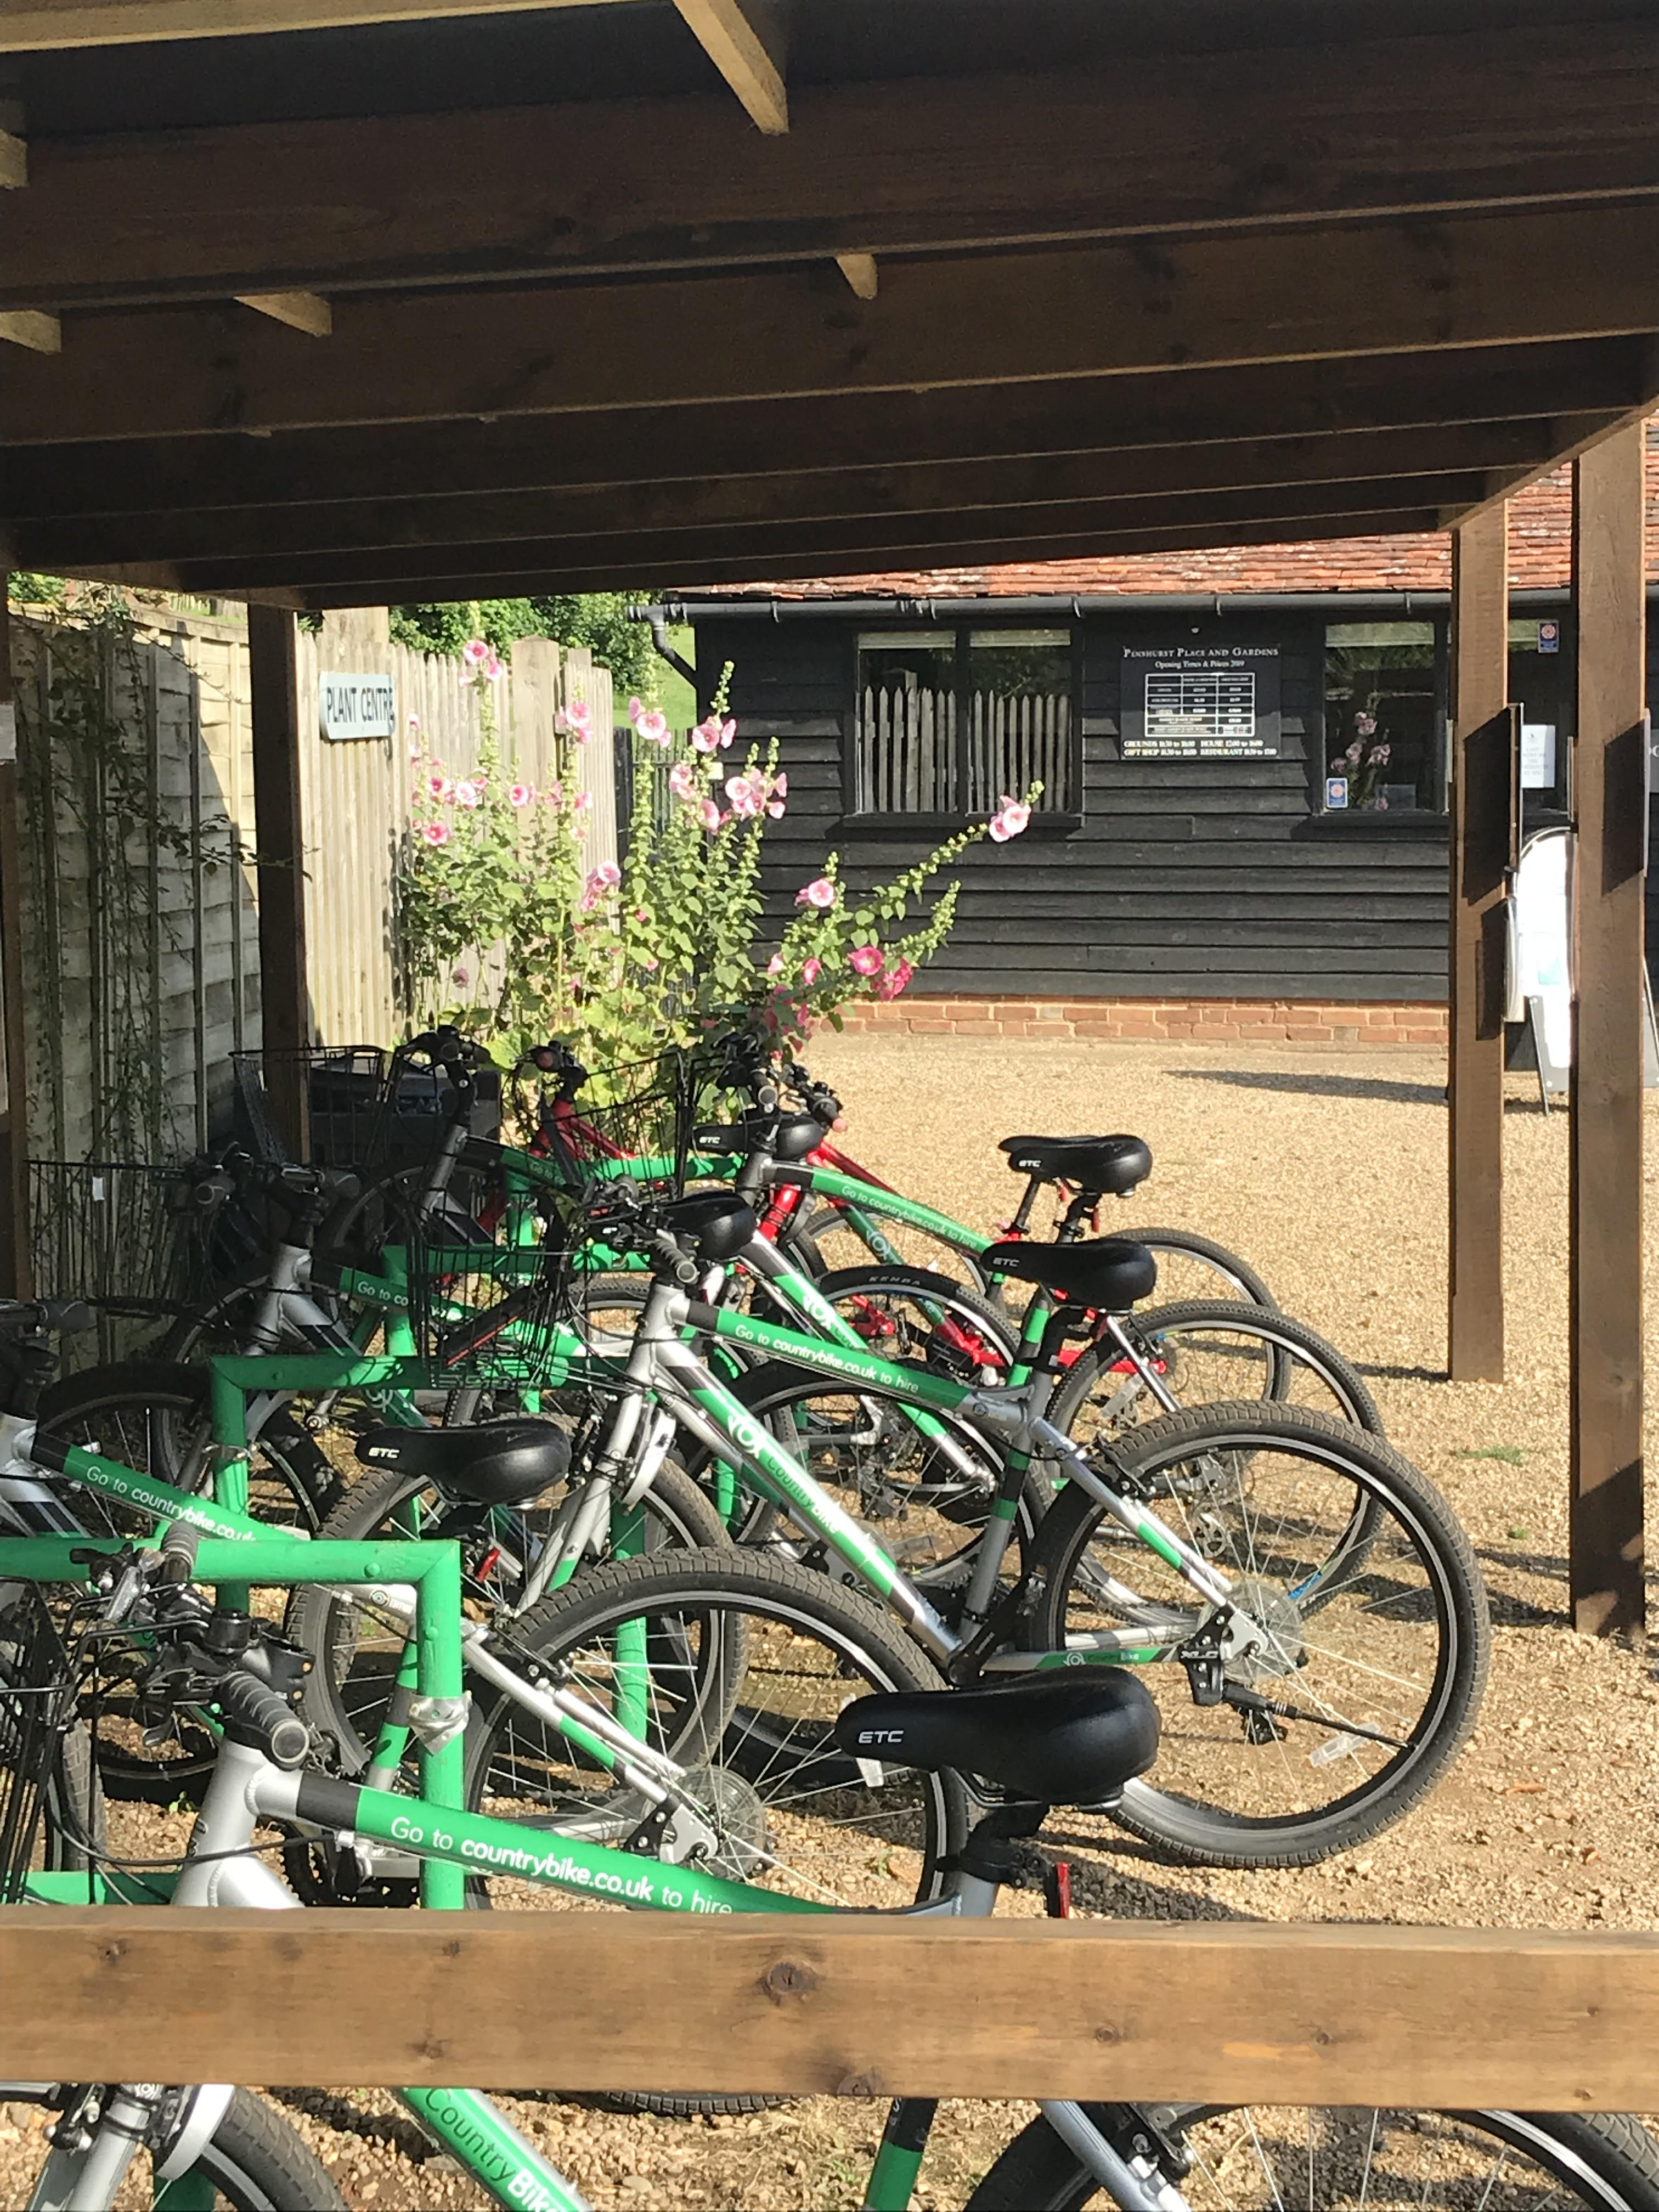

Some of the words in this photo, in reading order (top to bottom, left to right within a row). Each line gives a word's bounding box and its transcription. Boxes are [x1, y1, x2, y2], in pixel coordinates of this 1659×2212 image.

[1177, 648, 1205, 657] PLACE
[1207, 648, 1229, 657] AND
[1232, 647, 1279, 657] GARDENS
[327, 687, 357, 723] PLANT
[361, 687, 394, 723] CENTRE
[1018, 1159, 1041, 1168] ETC
[842, 1186, 856, 1198] Go
[857, 1192, 868, 1203] to
[868, 1198, 946, 1235] countrybike.co.uk
[948, 1229, 958, 1240] to
[958, 1233, 977, 1249] hire
[992, 1257, 1020, 1268] ETC
[868, 1276, 921, 1285] KENDA
[357, 1280, 376, 1296] Go
[379, 1289, 391, 1302] to
[735, 1324, 754, 1342] Go
[757, 1331, 770, 1346] to
[772, 1338, 878, 1380] countrybike.co.uk
[880, 1368, 893, 1385] to
[896, 1372, 919, 1393] hire
[368, 1446, 400, 1459] ETC
[86, 1465, 108, 1486] Go
[111, 1477, 127, 1494] to
[1180, 1651, 1218, 1659] XLC
[858, 1730, 904, 1744] ETC
[391, 1816, 423, 1844] Go
[433, 1829, 453, 1851] to
[461, 1841, 653, 1901] countrybike.co.uk
[662, 1886, 683, 1908] to
[691, 1889, 732, 1914] hire
[425, 2088, 558, 2211] CountryBik
